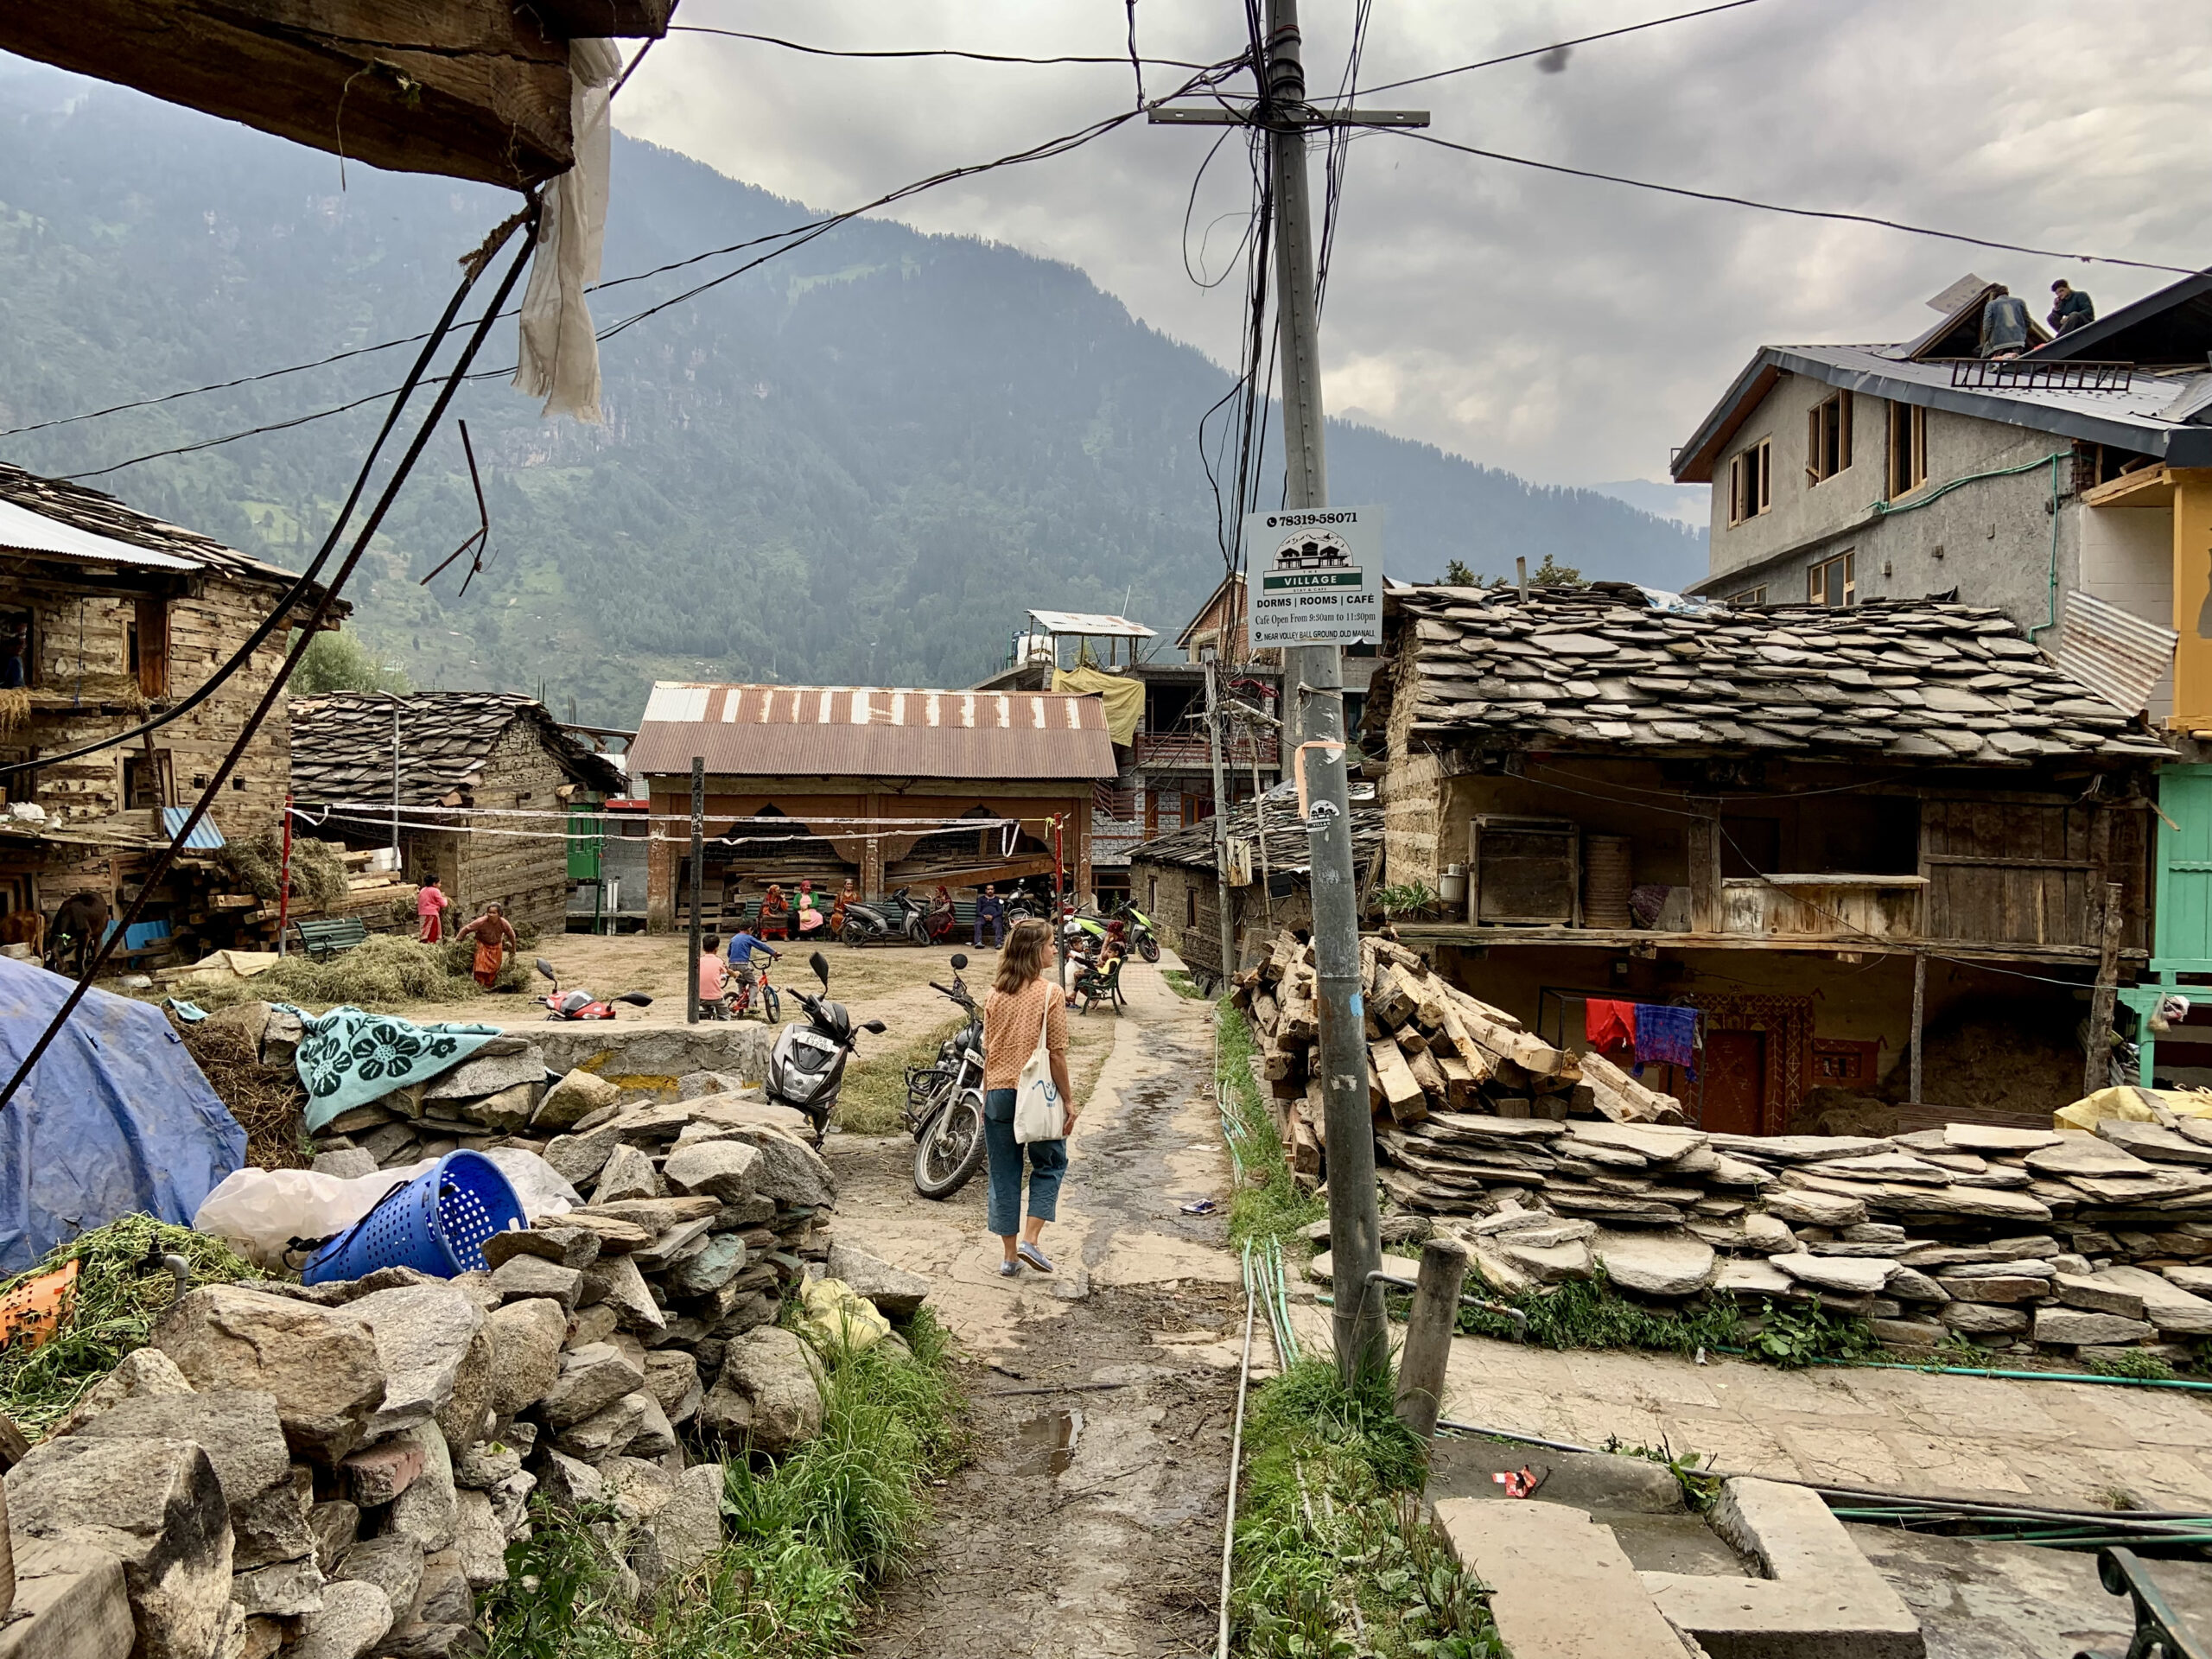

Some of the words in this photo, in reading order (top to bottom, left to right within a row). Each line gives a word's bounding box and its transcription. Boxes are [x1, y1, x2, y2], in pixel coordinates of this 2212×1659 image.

[1279, 512, 1357, 527] 78319-58071
[1284, 575, 1338, 586] VILLAGE
[1256, 598, 1292, 608] DORMS
[1300, 595, 1338, 606] ROOMS
[1346, 593, 1375, 604] CAFÉ
[1255, 614, 1270, 625] Café
[1271, 614, 1289, 626] Open
[1290, 613, 1308, 623] From
[1309, 613, 1334, 622] 9:30am
[1346, 612, 1376, 624] 11:30pm
[1299, 631, 1313, 639] BALL
